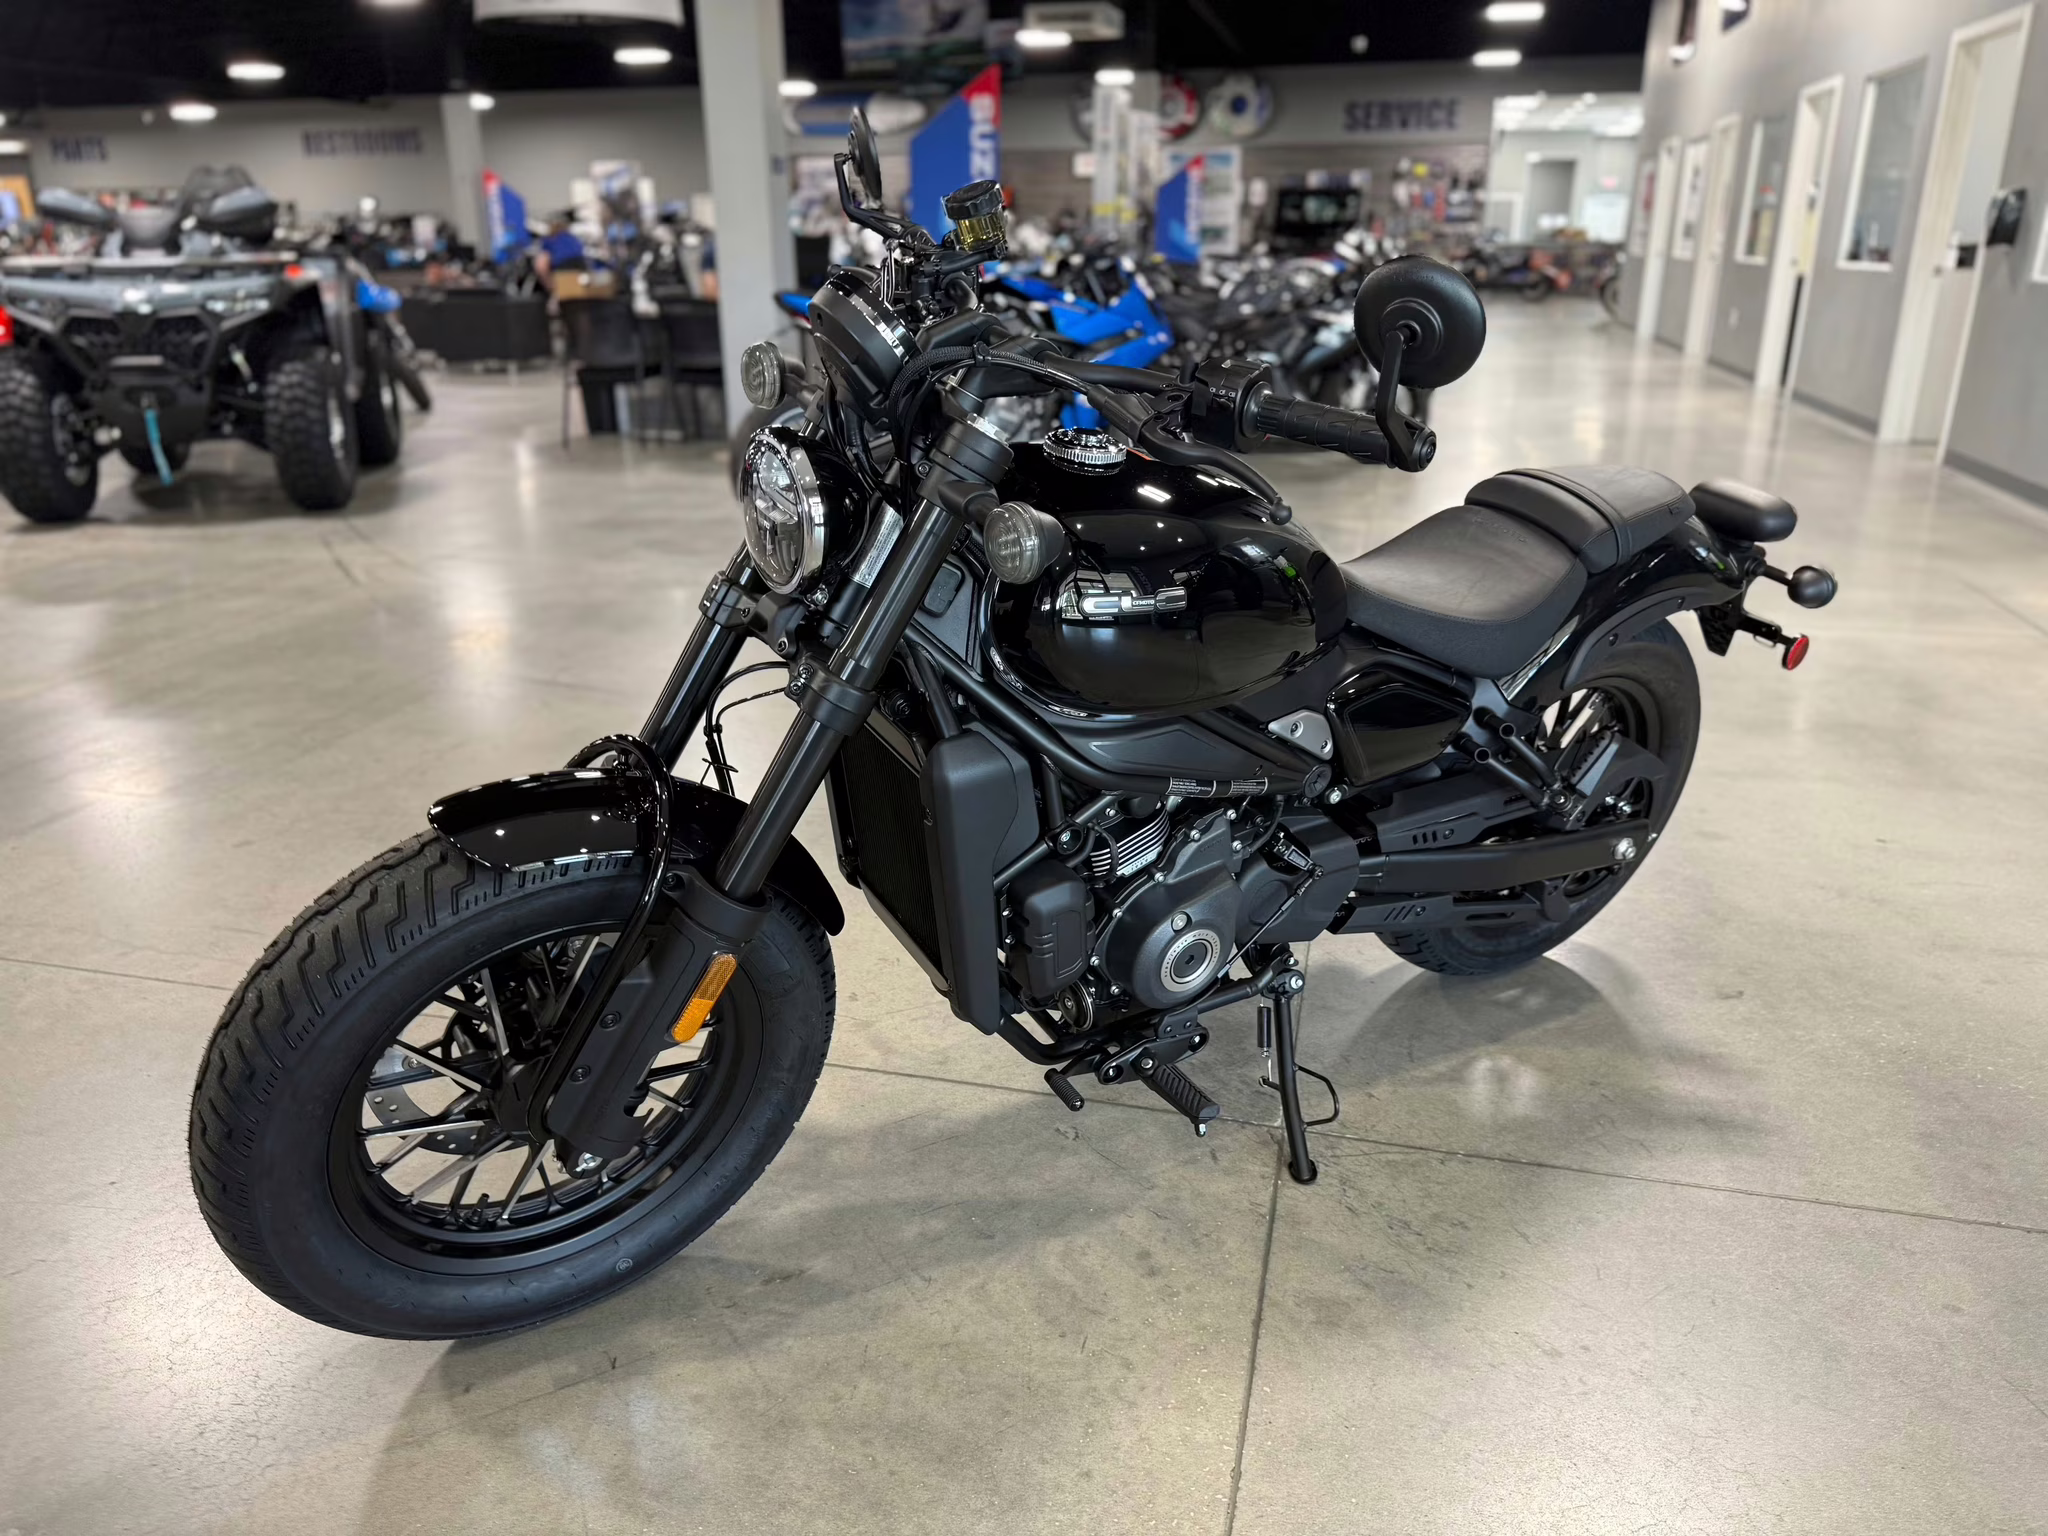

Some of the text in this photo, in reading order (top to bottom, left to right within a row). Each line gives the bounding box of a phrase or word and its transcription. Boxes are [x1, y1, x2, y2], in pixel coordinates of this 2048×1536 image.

[1344, 98, 1459, 132] SERVICE
[50, 137, 109, 163] PARTS
[303, 129, 422, 156] RESTROOMS
